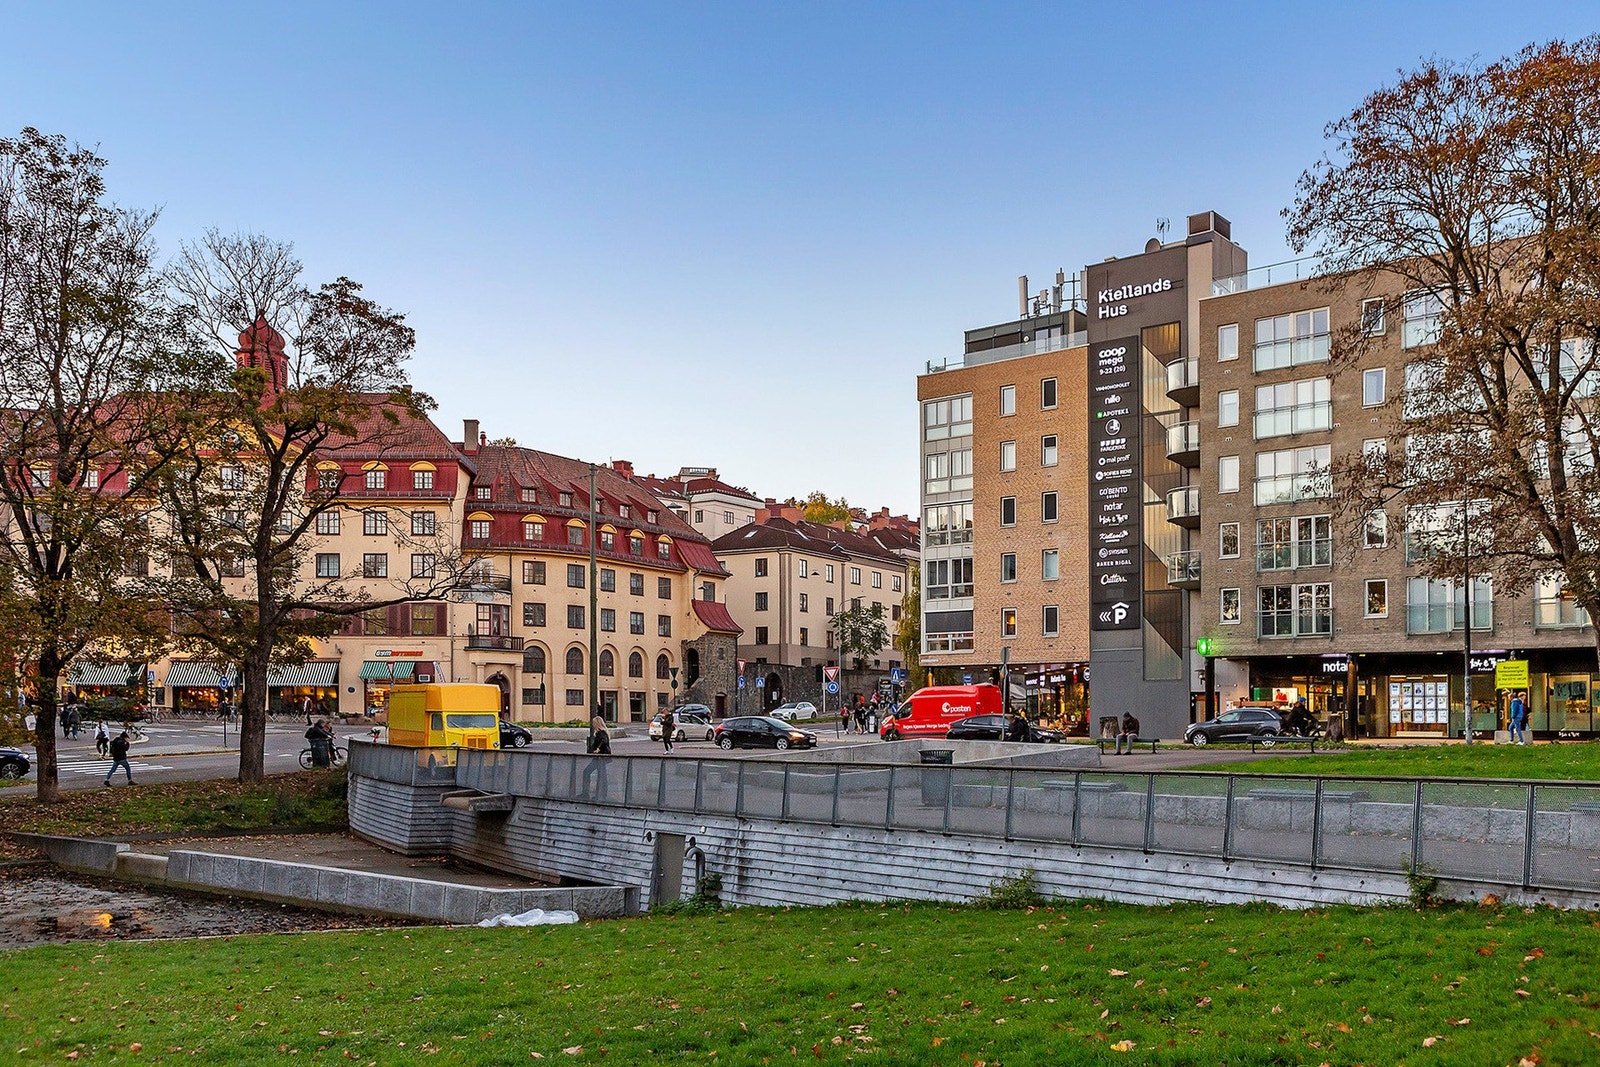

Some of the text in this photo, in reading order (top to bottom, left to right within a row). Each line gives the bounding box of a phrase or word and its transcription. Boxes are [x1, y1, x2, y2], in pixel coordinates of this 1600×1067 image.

[1098, 278, 1171, 304] Kiellands
[1098, 304, 1128, 319] Hus
[1099, 346, 1126, 358] coop
[1099, 357, 1123, 366] mega
[1104, 502, 1123, 511] notar
[1115, 608, 1127, 624] P
[1323, 660, 1348, 672] nota
[950, 705, 972, 713] posten
